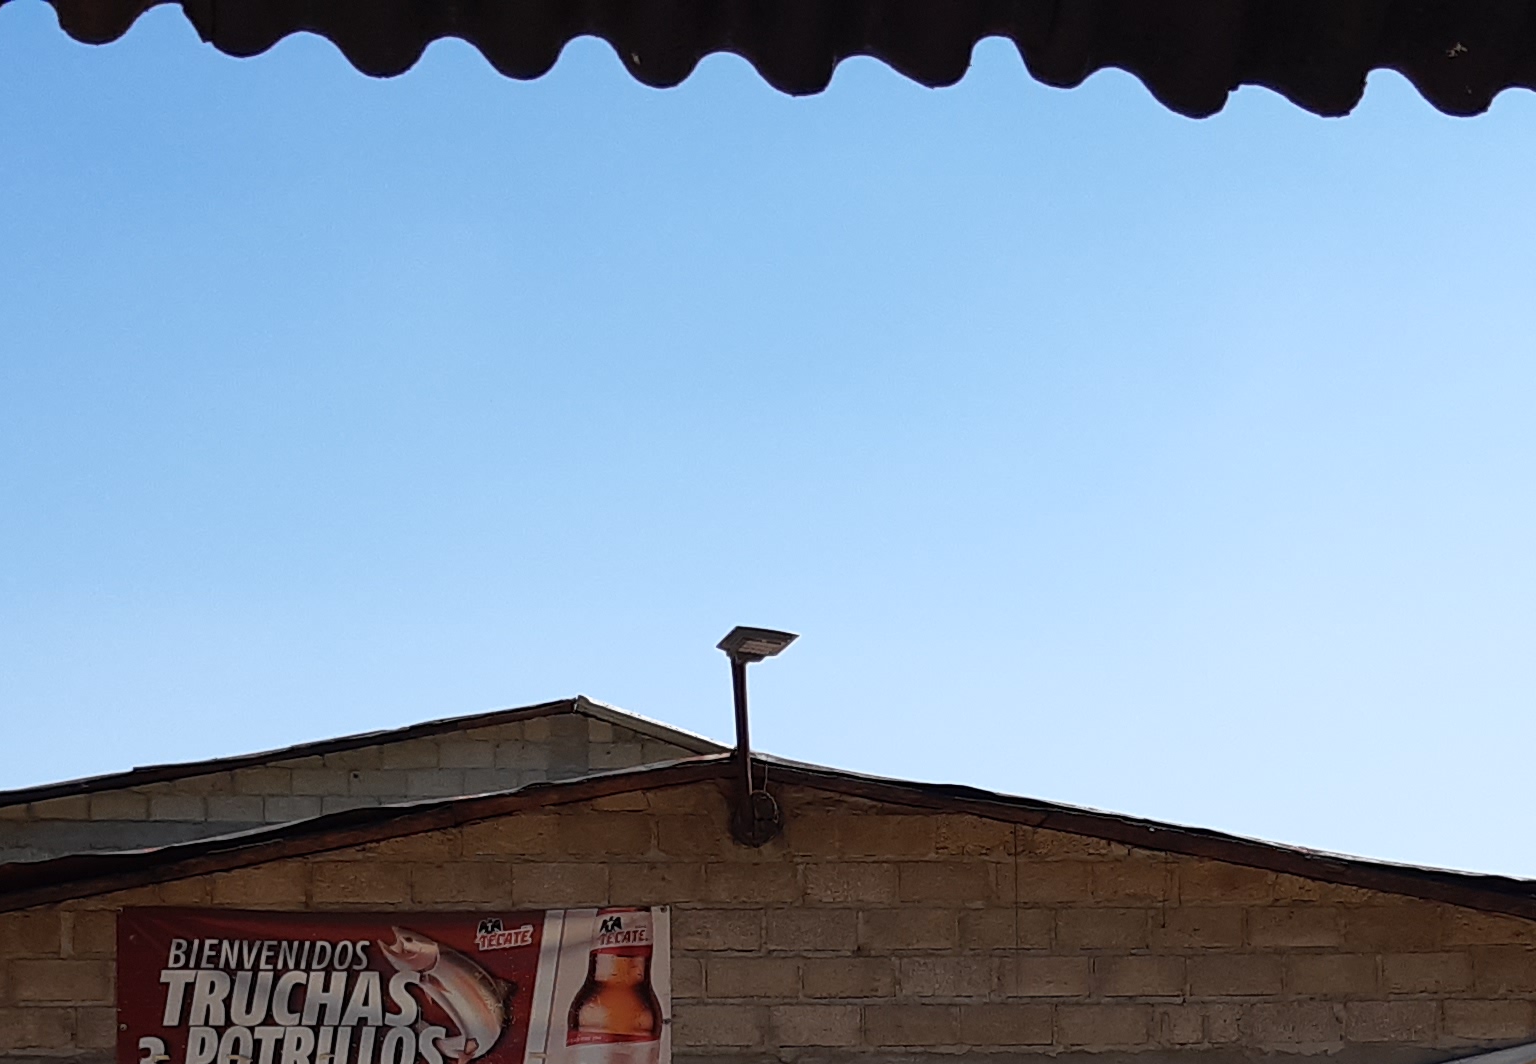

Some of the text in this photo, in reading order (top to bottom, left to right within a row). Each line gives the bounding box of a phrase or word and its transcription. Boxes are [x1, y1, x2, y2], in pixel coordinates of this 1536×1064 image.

[477, 930, 531, 947] TECATE
[167, 939, 371, 971] BIENVENIDOS
[160, 969, 421, 1027] TRUCHAS
